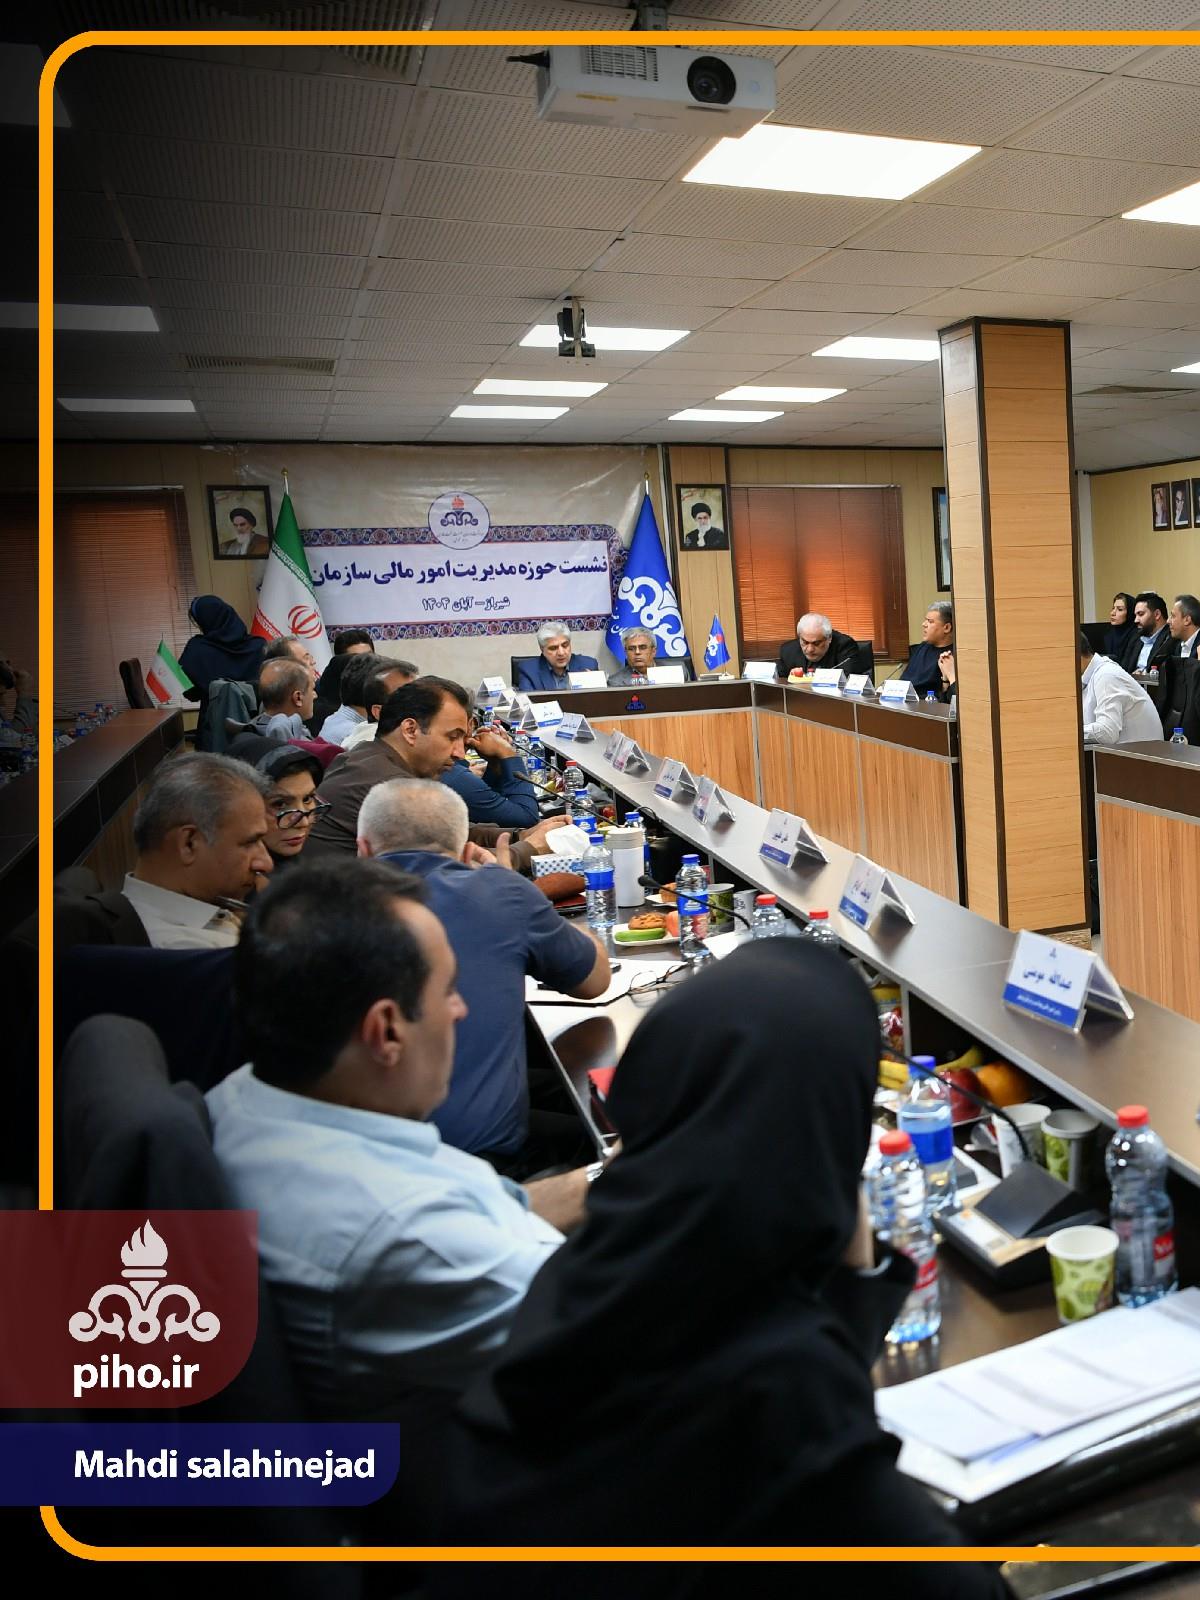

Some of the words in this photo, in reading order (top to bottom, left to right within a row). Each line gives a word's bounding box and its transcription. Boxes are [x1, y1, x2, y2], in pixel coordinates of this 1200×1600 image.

[312, 561, 372, 587] سازمان
[373, 560, 414, 585] مالی
[416, 560, 450, 584] امور
[452, 561, 517, 582] مدیریت
[518, 561, 557, 581] حوزه
[559, 555, 608, 575] نشست
[451, 596, 474, 613] آبان
[485, 595, 511, 611] شیراز
